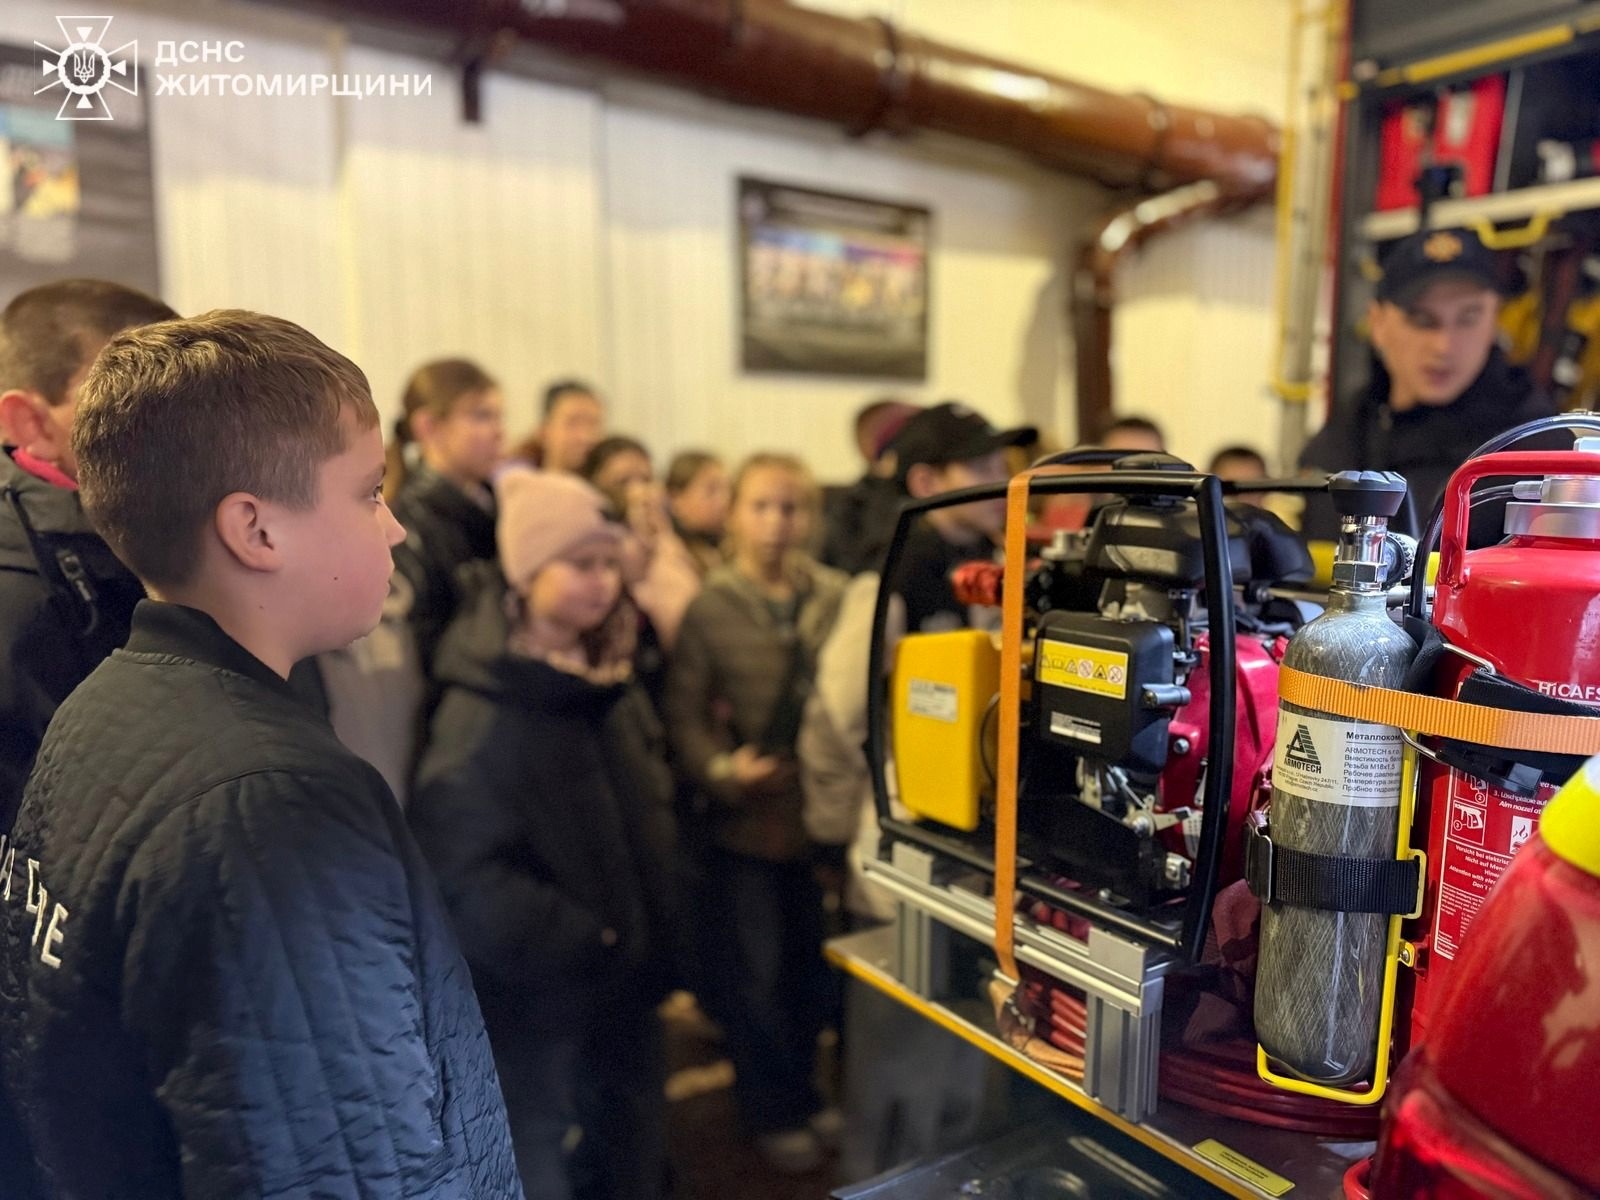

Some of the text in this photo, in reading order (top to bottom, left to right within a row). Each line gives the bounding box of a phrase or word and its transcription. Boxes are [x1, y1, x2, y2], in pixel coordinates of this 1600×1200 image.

[1345, 747, 1386, 755] ARMOTECH
[1284, 757, 1322, 775] ARMOTECH
[1344, 769, 1373, 778] Рабочее
[1499, 800, 1513, 809] Aim
